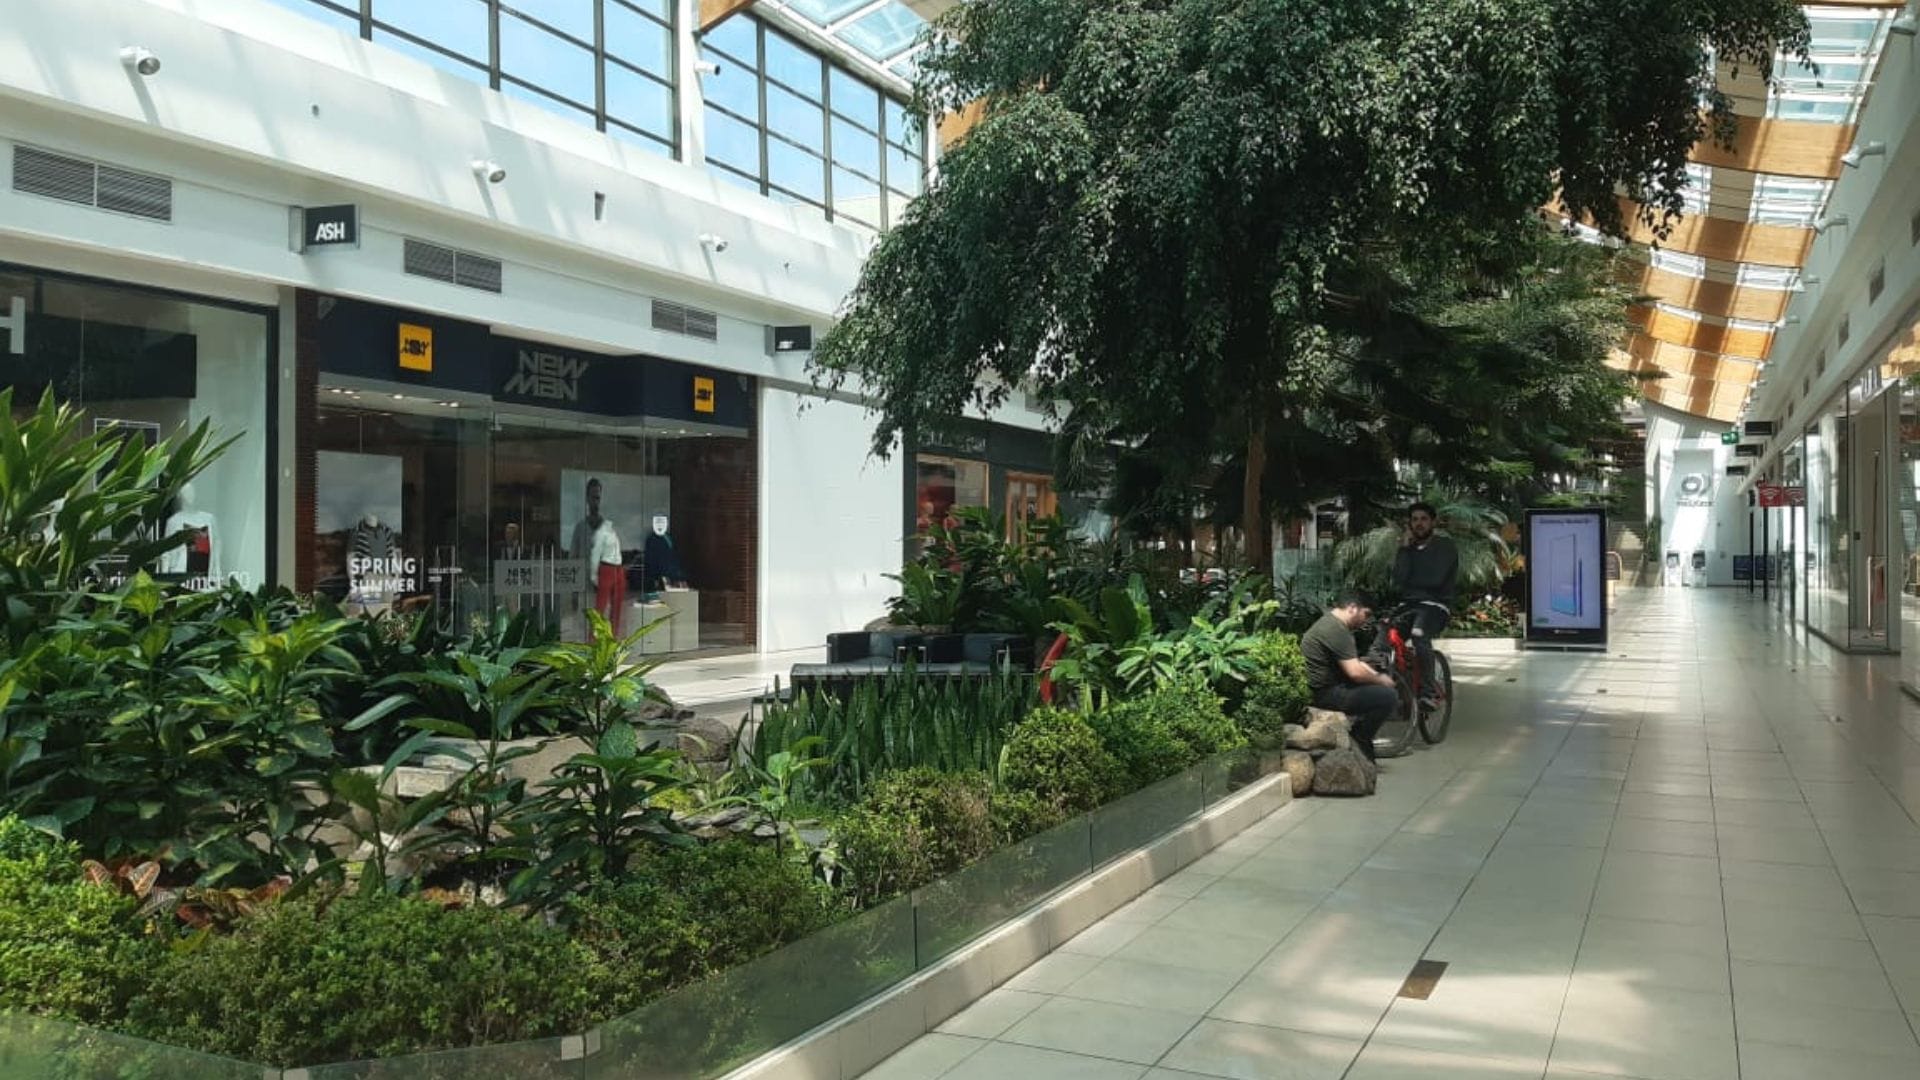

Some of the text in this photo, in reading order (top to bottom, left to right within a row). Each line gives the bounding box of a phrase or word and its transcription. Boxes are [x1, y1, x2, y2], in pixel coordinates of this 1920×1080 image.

[314, 221, 346, 242] ASH
[350, 557, 416, 575] SPRING
[350, 577, 416, 594] SUMMER
